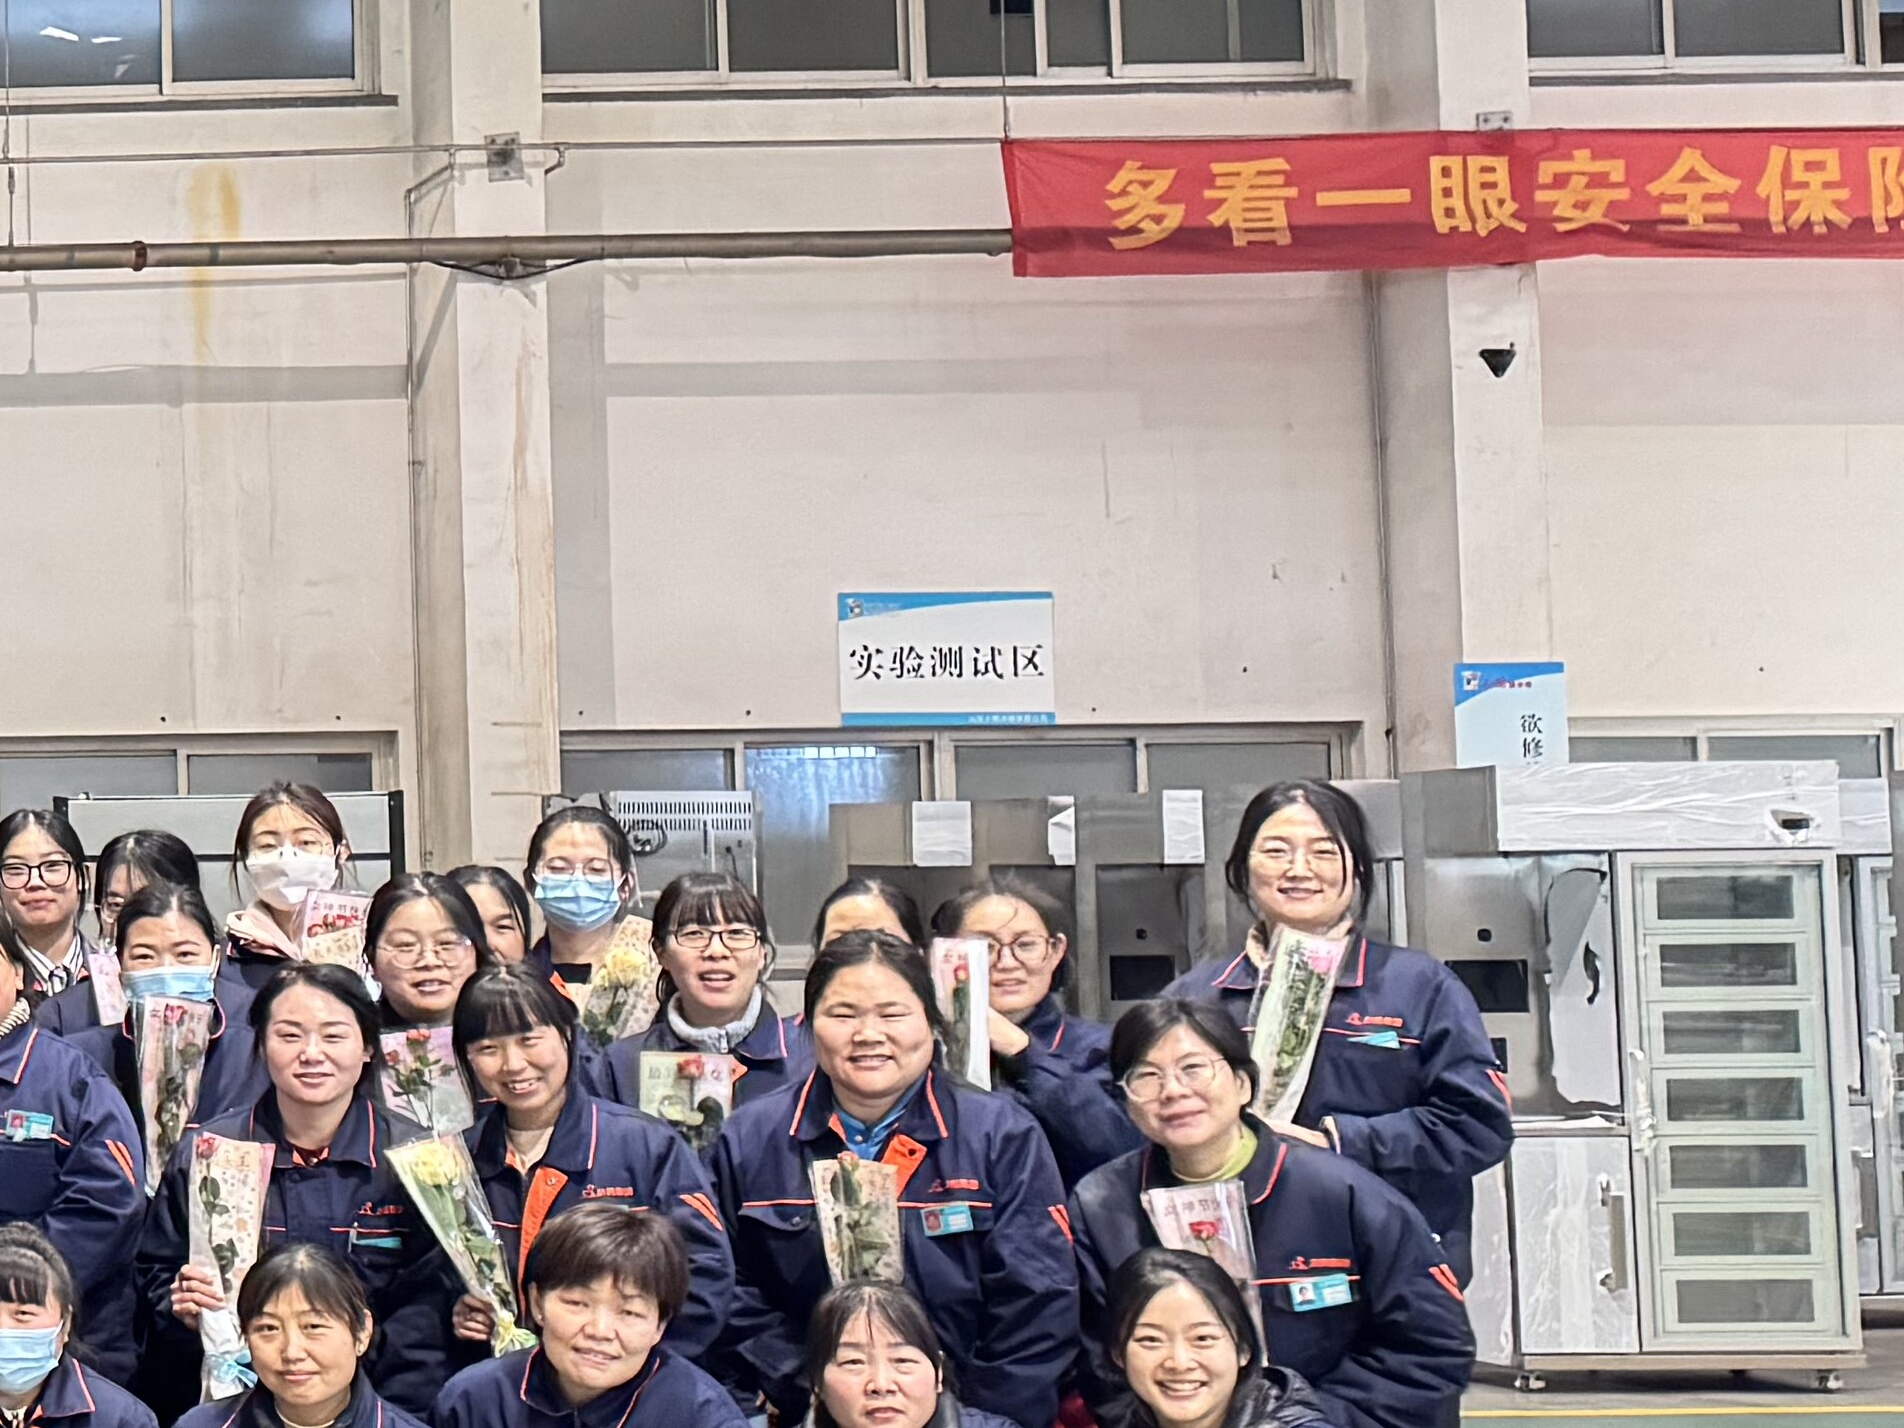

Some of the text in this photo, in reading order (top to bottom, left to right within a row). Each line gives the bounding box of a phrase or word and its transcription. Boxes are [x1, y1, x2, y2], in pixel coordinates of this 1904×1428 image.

[849, 644, 1045, 680] 实验测试区
[1520, 713, 1543, 766] 欲修
